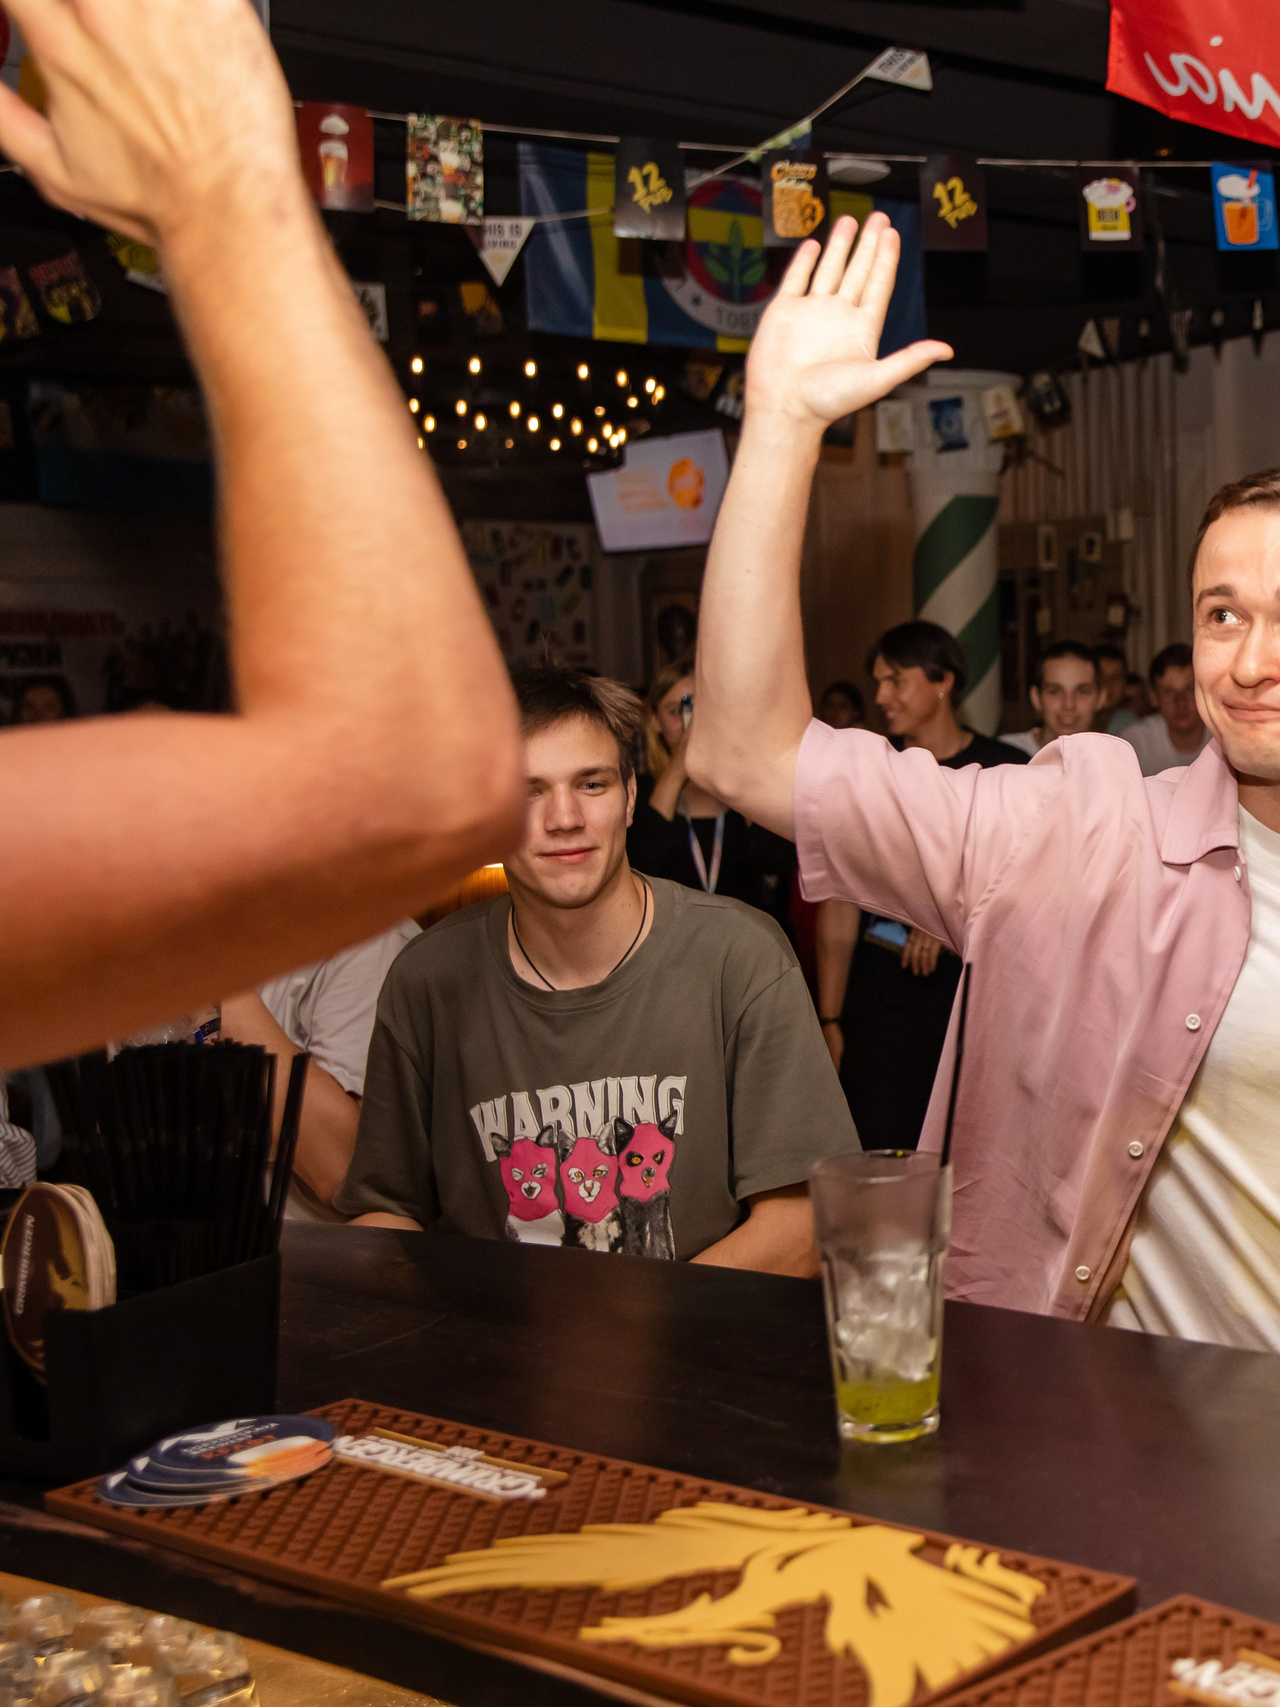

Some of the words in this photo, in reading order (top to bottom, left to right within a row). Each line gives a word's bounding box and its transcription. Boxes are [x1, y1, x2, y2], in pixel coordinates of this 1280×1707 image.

[627, 161, 666, 202] 12
[933, 176, 970, 218] 12
[470, 1074, 687, 1162] WARNING
